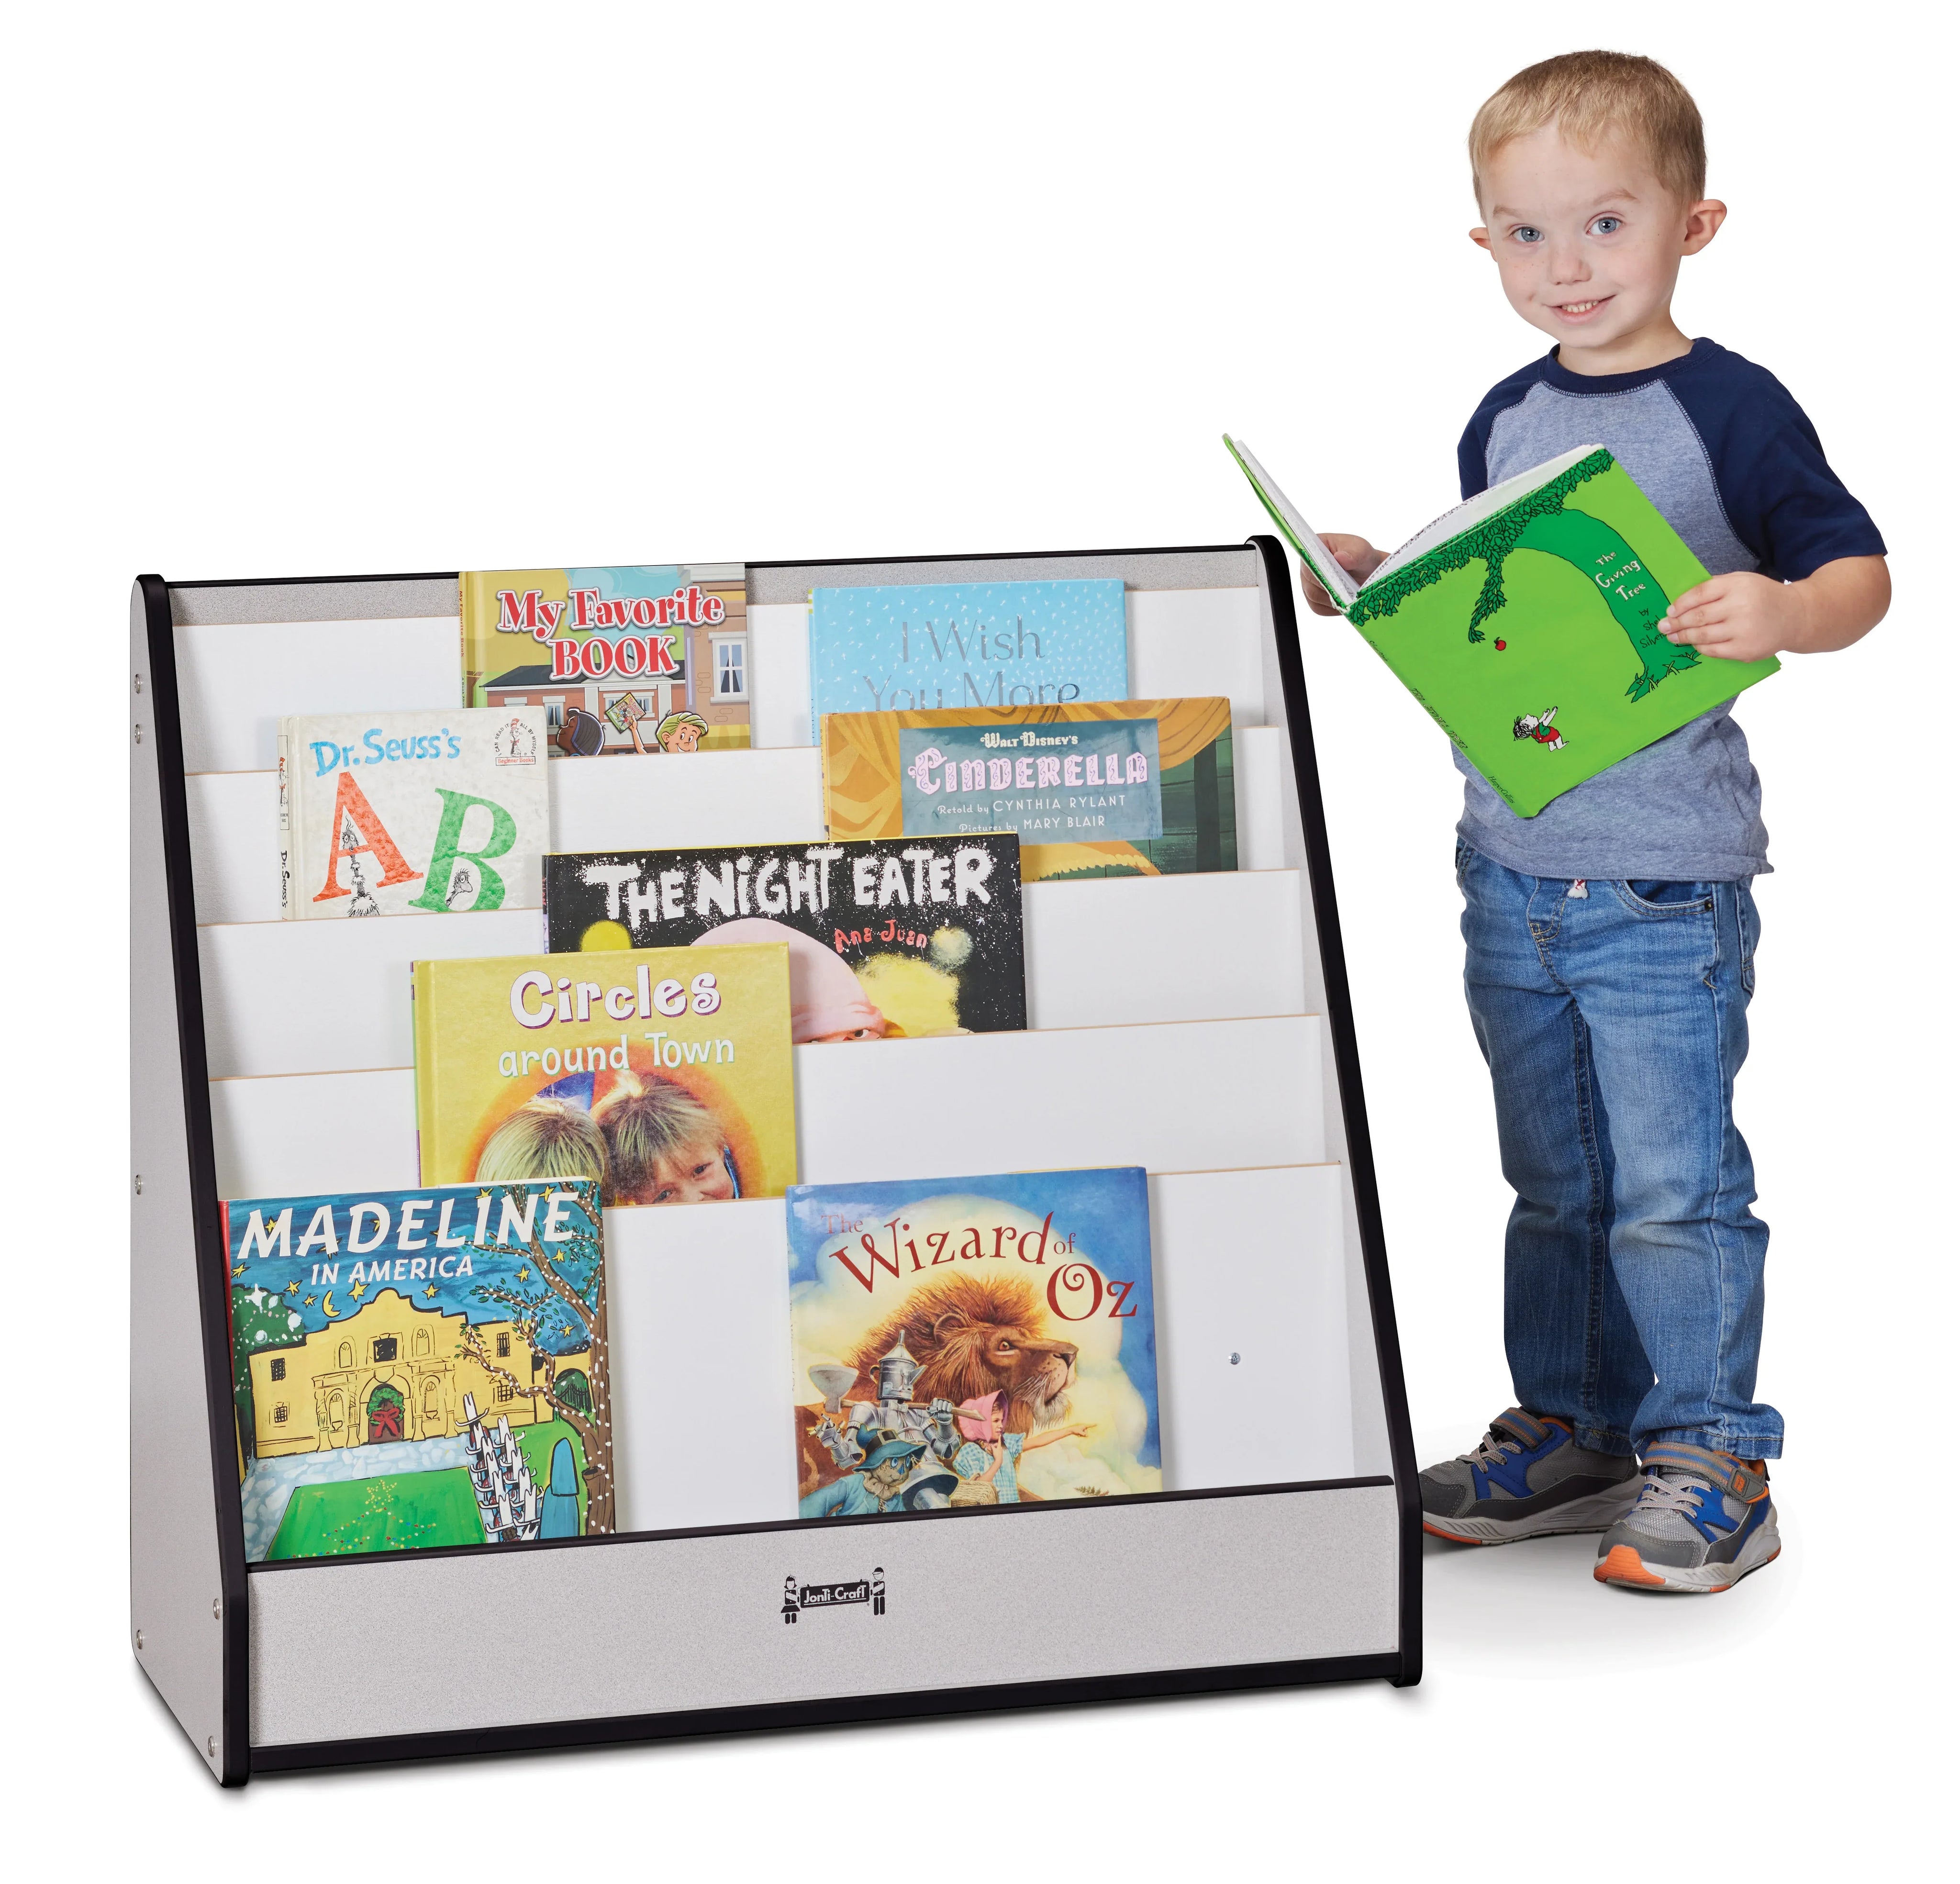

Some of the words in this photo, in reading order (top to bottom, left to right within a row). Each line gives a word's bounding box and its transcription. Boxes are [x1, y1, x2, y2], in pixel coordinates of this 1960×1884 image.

[1595, 552, 1616, 565] The
[1595, 560, 1641, 588] Giving
[1615, 583, 1646, 601] Tree
[496, 590, 565, 642] My
[568, 586, 724, 631] Favorite
[1638, 608, 1649, 616] by
[1643, 615, 1660, 631] Shel
[903, 622, 908, 663] I
[925, 616, 1045, 663] Wish
[547, 635, 679, 680] BOOK
[862, 674, 943, 712] You
[964, 671, 1080, 708] More
[495, 727, 504, 740] READ
[310, 741, 360, 777] Dr.
[363, 728, 461, 764] Seuss's
[938, 804, 973, 814] Retold
[978, 804, 989, 814] by
[993, 798, 1061, 812] CYNTHIA
[1070, 795, 1125, 808] RYLANT
[1488, 776, 1515, 803] HarperCollins
[959, 823, 1002, 833] Pictures
[1006, 822, 1018, 832] by
[1024, 817, 1060, 830] MARY
[1068, 815, 1105, 827] BLAIR
[585, 864, 686, 928] THE
[854, 846, 994, 907] EATER
[834, 929, 872, 954] Ana
[880, 920, 927, 948] Juan
[510, 964, 721, 1029] Circles
[499, 1034, 630, 1078] around
[645, 1032, 735, 1068] Town
[237, 1192, 579, 1260] MADELINE
[821, 1215, 864, 1234] The
[829, 1211, 1054, 1293] Wizard
[1053, 1232, 1075, 1255] of
[311, 1264, 339, 1286] IN
[348, 1256, 473, 1284] AMERICA
[1047, 1263, 1137, 1321] Oz
